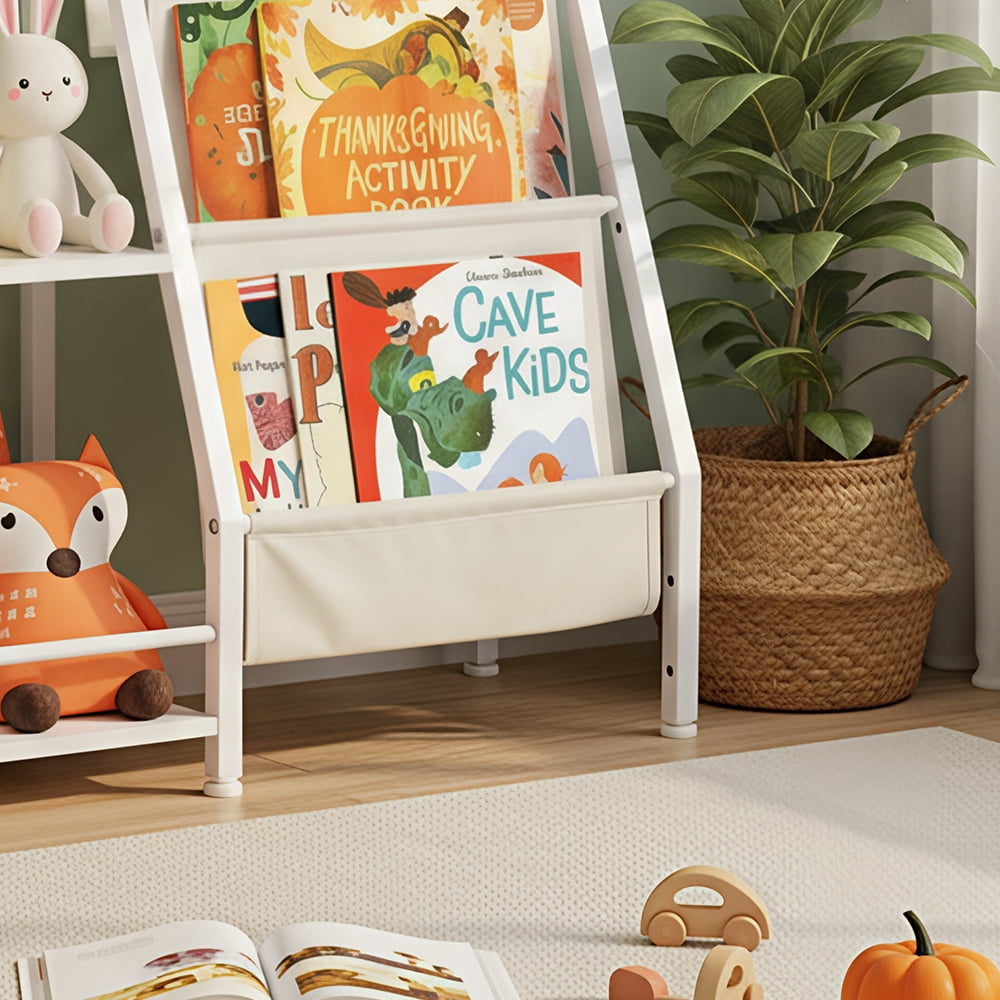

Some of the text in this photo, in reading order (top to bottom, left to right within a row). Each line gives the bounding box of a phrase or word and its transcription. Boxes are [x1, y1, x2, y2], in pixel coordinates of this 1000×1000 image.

[345, 153, 478, 201] ACTIVITY
[453, 285, 560, 344] CAVE
[239, 457, 303, 503] MY
